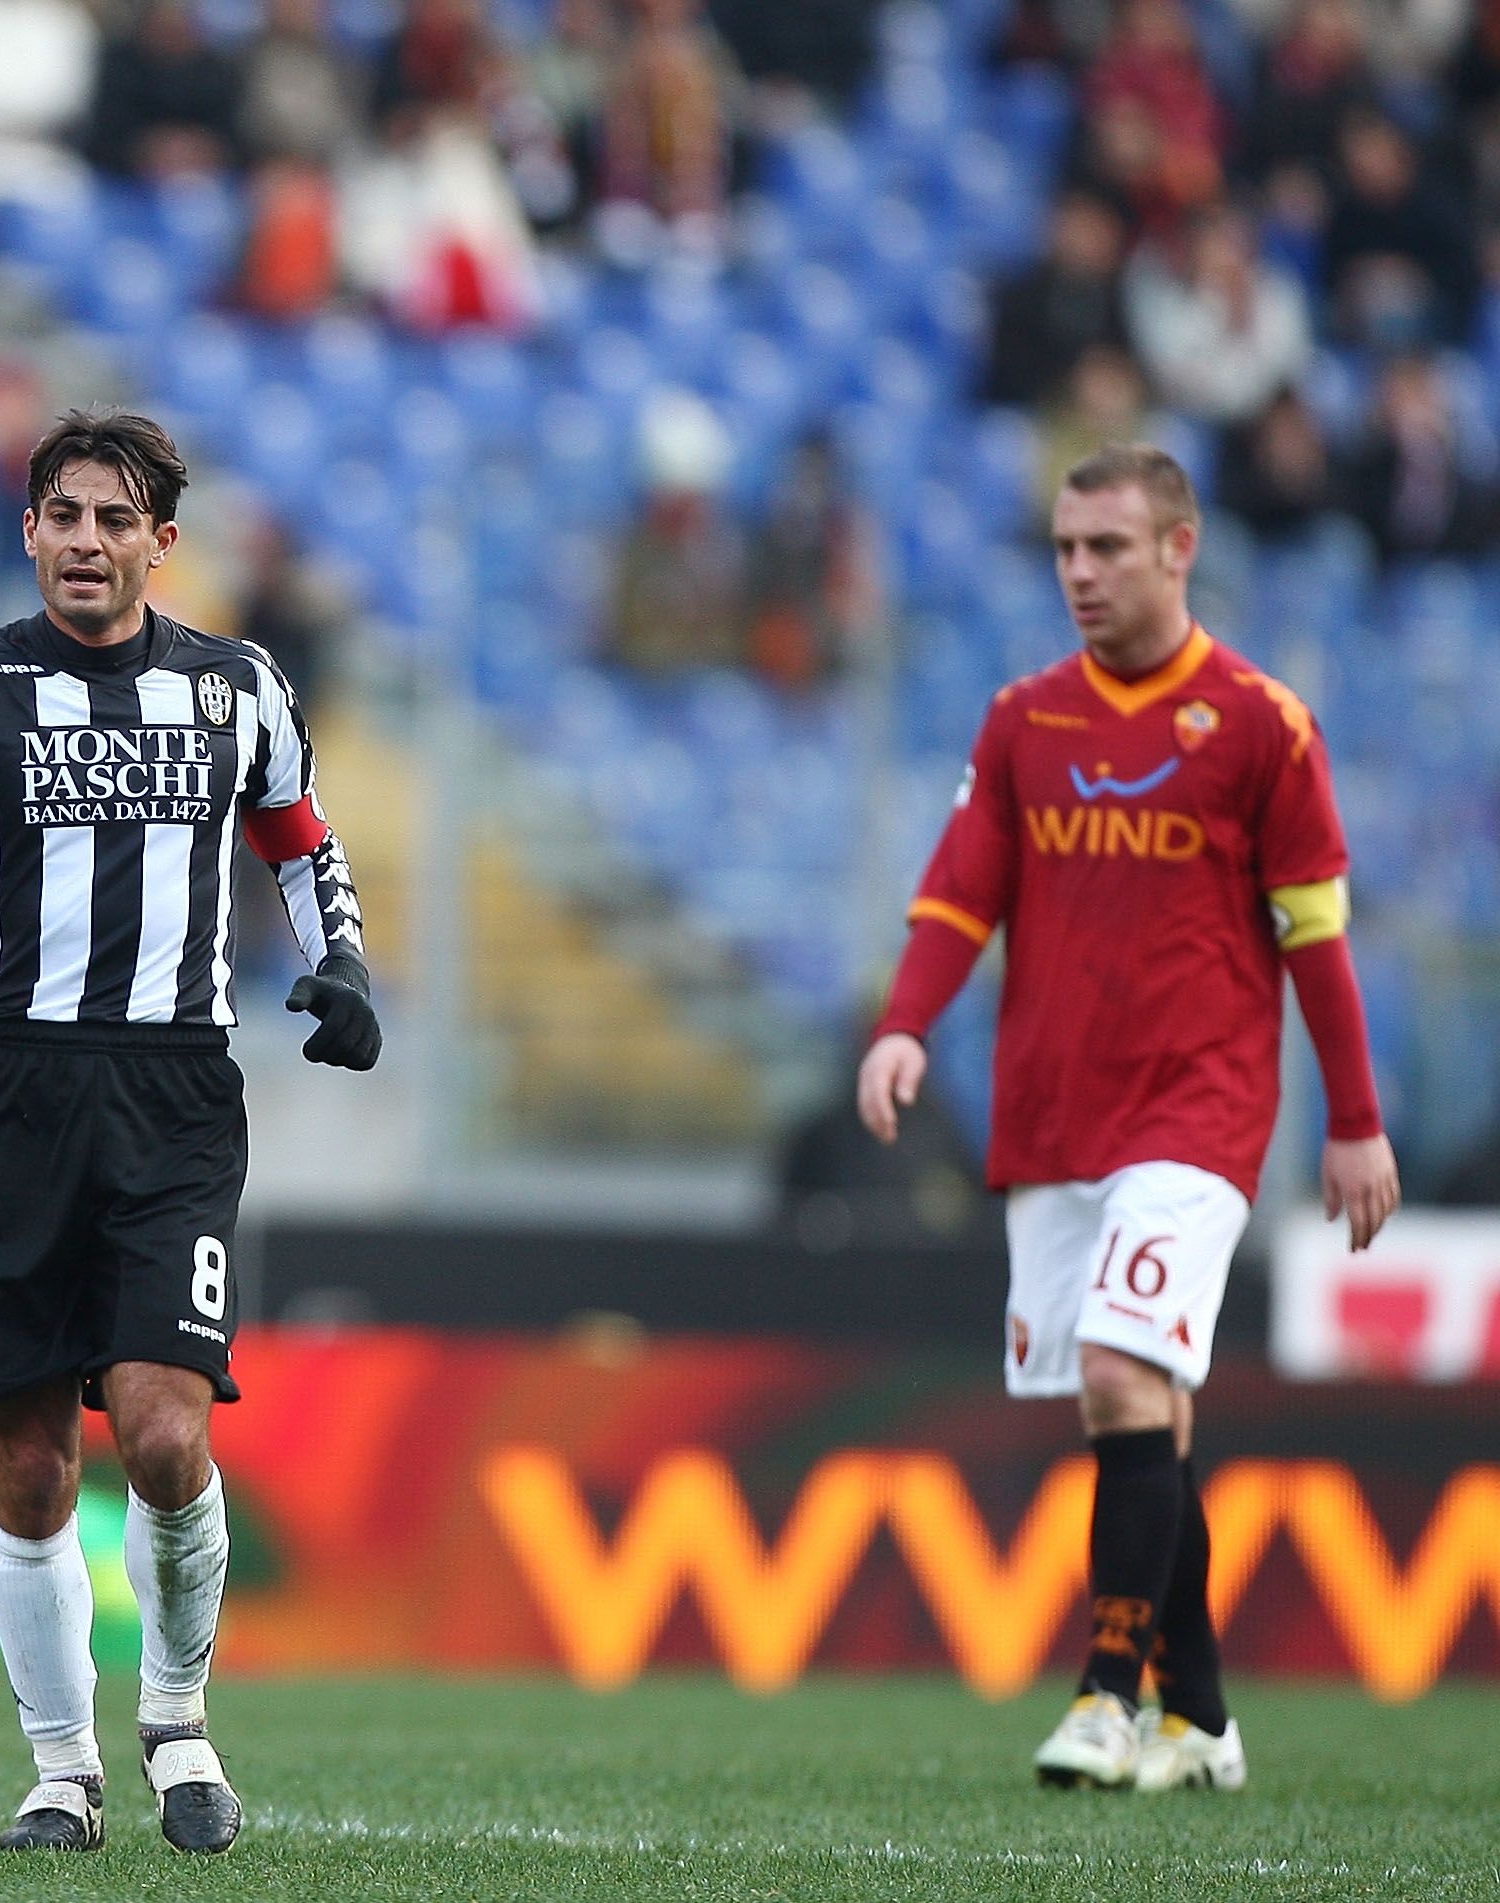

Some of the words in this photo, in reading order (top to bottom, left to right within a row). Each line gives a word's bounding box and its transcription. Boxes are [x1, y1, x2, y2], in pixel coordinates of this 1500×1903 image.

[20, 729, 213, 766] MONTE
[21, 763, 212, 802] PASCHI
[24, 802, 108, 825] BANCA
[114, 801, 166, 820] DAL
[169, 799, 211, 821] 1472
[1025, 806, 1206, 861] WIND
[191, 1235, 228, 1321] 8
[1091, 1225, 1177, 1298] 16
[178, 1319, 226, 1344] Kappa
